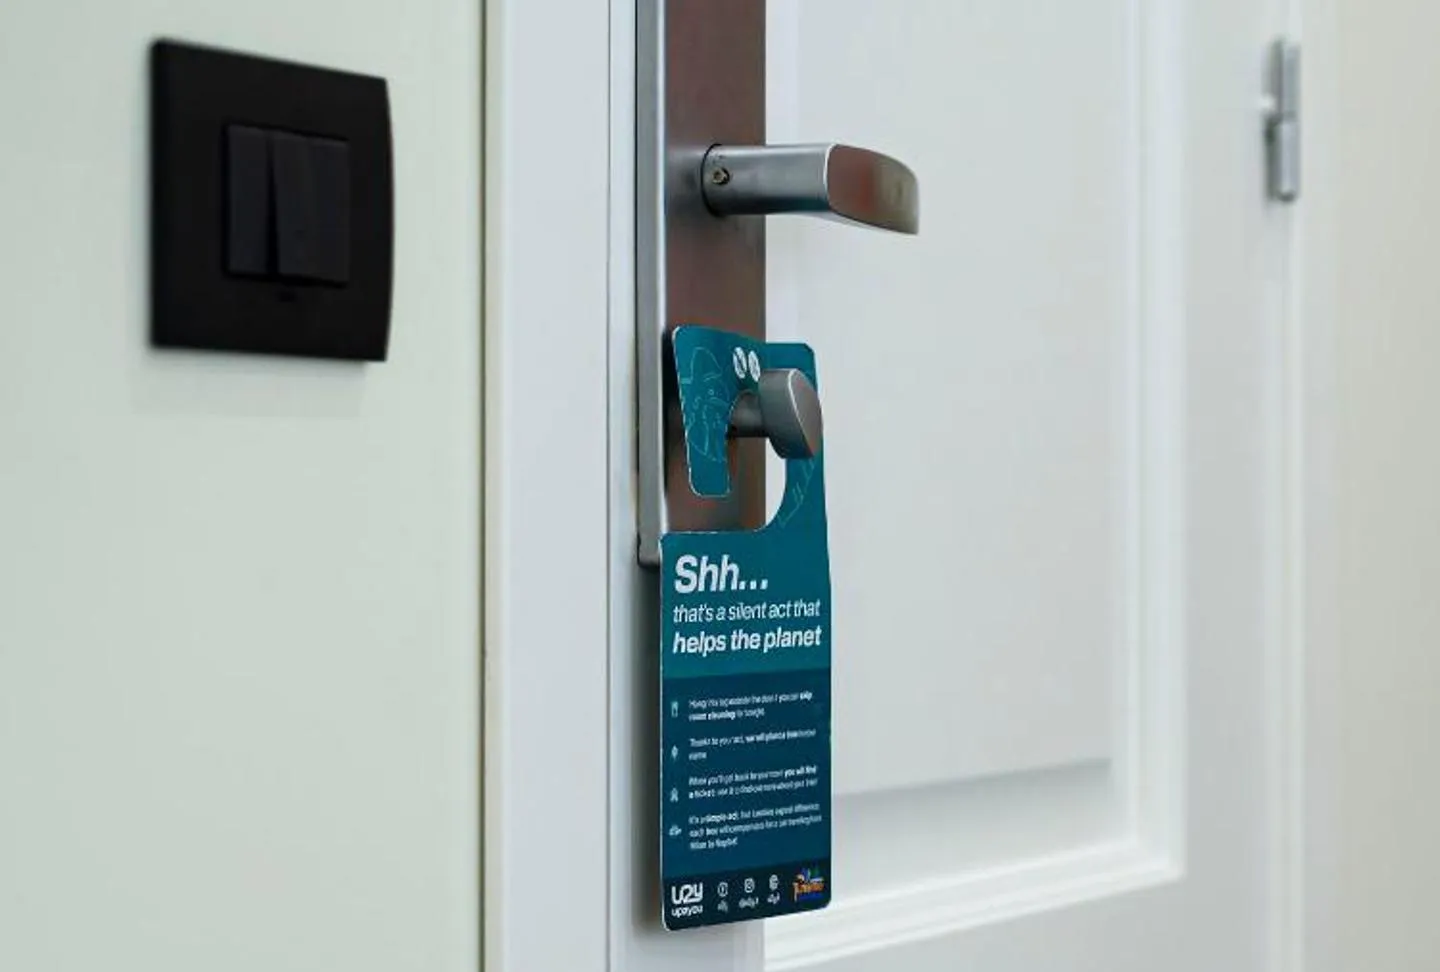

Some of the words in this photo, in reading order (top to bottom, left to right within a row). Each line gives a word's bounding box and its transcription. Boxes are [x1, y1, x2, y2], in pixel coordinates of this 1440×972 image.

[674, 554, 768, 594] Shh...
[673, 604, 713, 623] that's
[715, 608, 726, 620] a
[728, 601, 767, 620] silent
[768, 600, 792, 618] act
[793, 598, 821, 617] that
[672, 631, 726, 657] helps
[730, 629, 761, 651] the
[763, 625, 822, 653] planet
